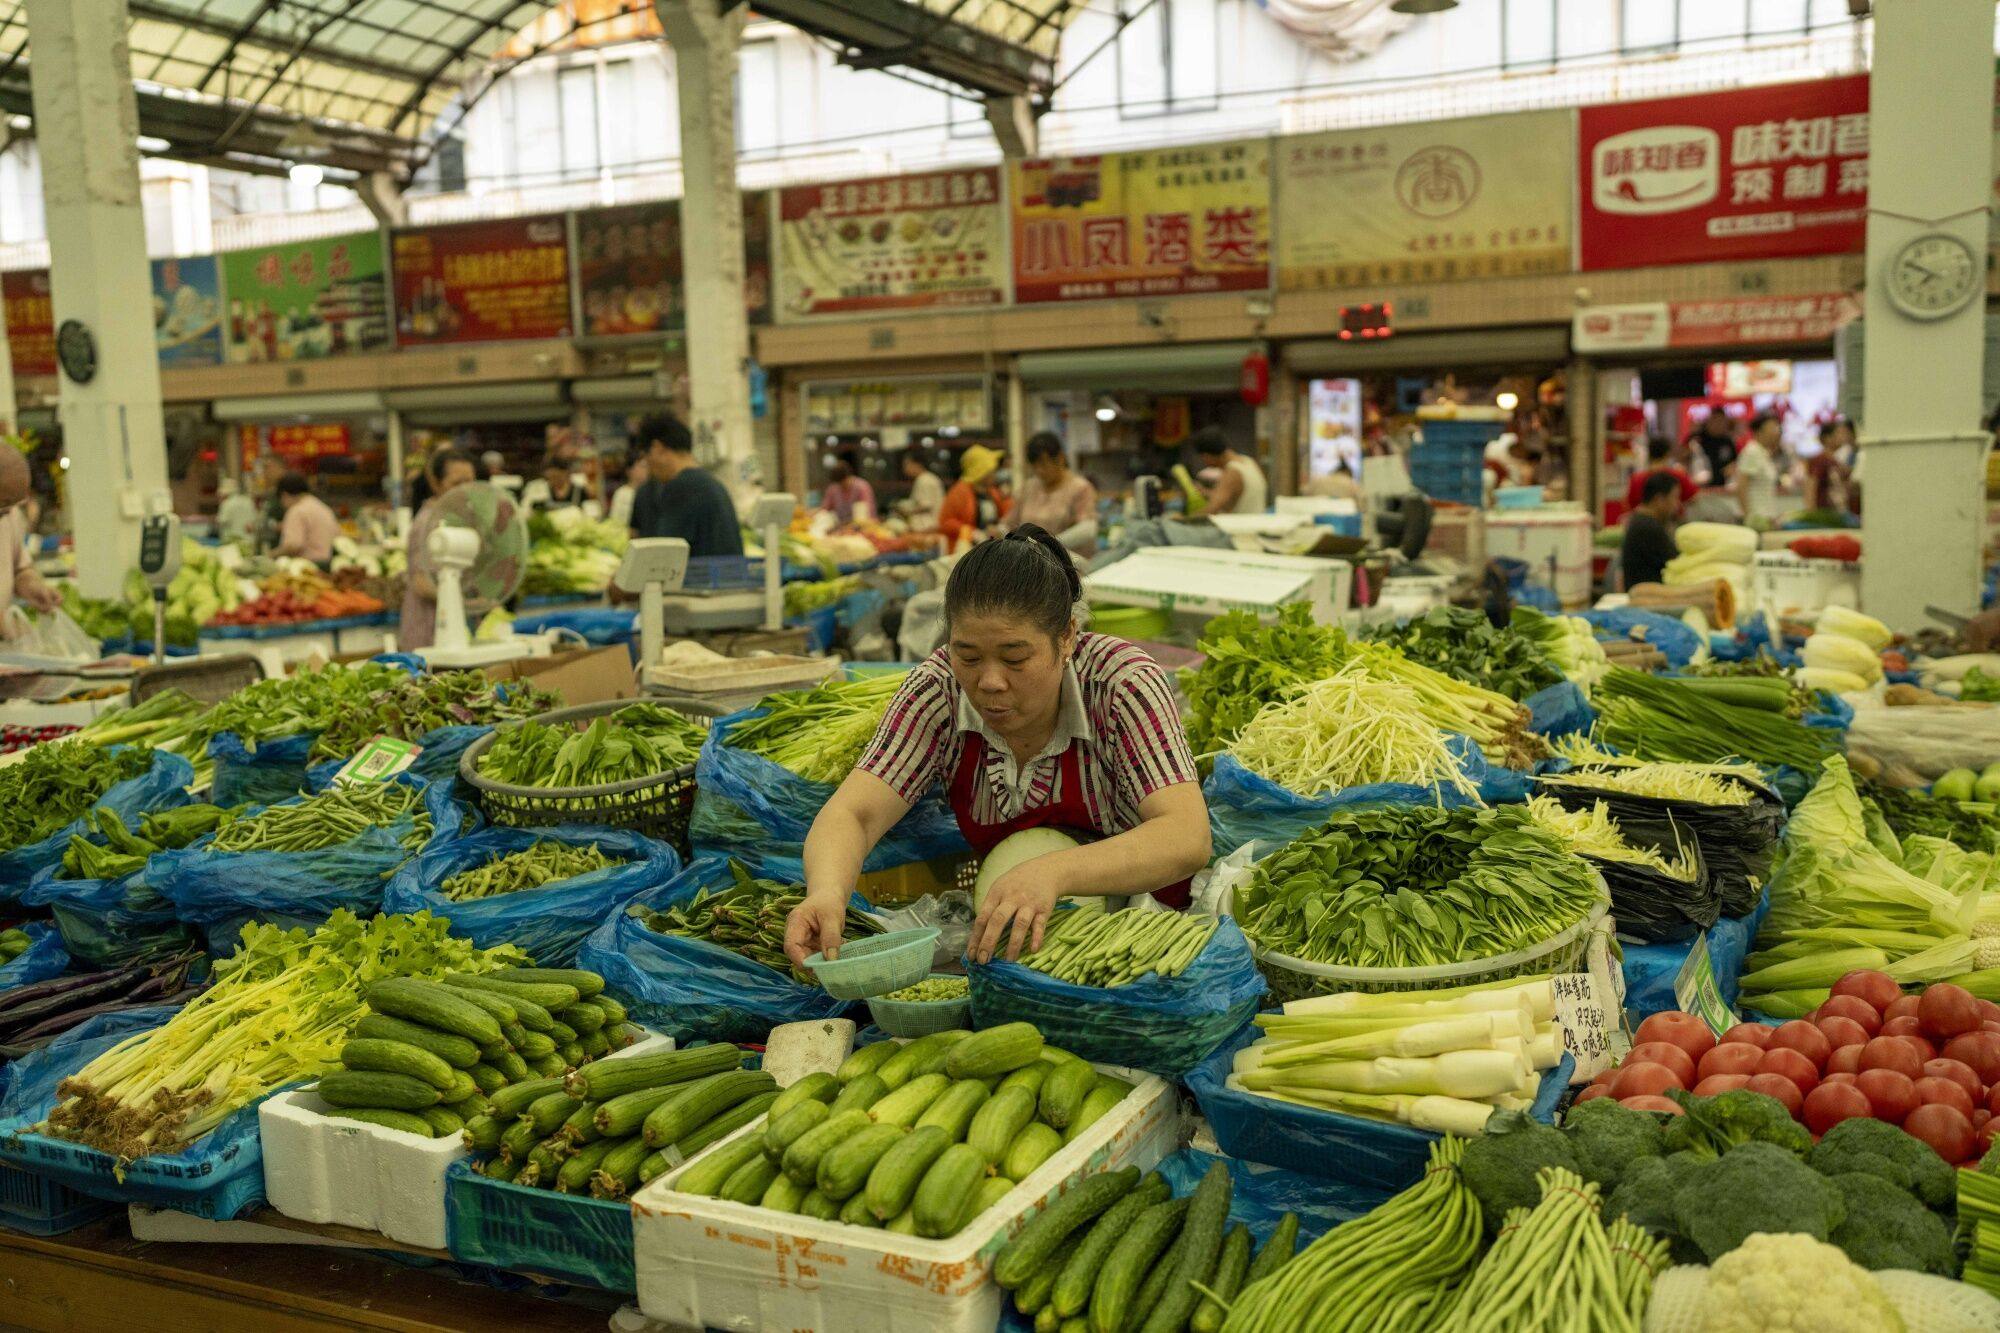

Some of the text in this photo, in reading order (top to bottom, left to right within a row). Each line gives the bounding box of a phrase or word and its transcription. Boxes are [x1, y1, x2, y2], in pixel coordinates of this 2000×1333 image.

[1602, 137, 1707, 177] 味知香
[1731, 113, 1868, 166] 味知香
